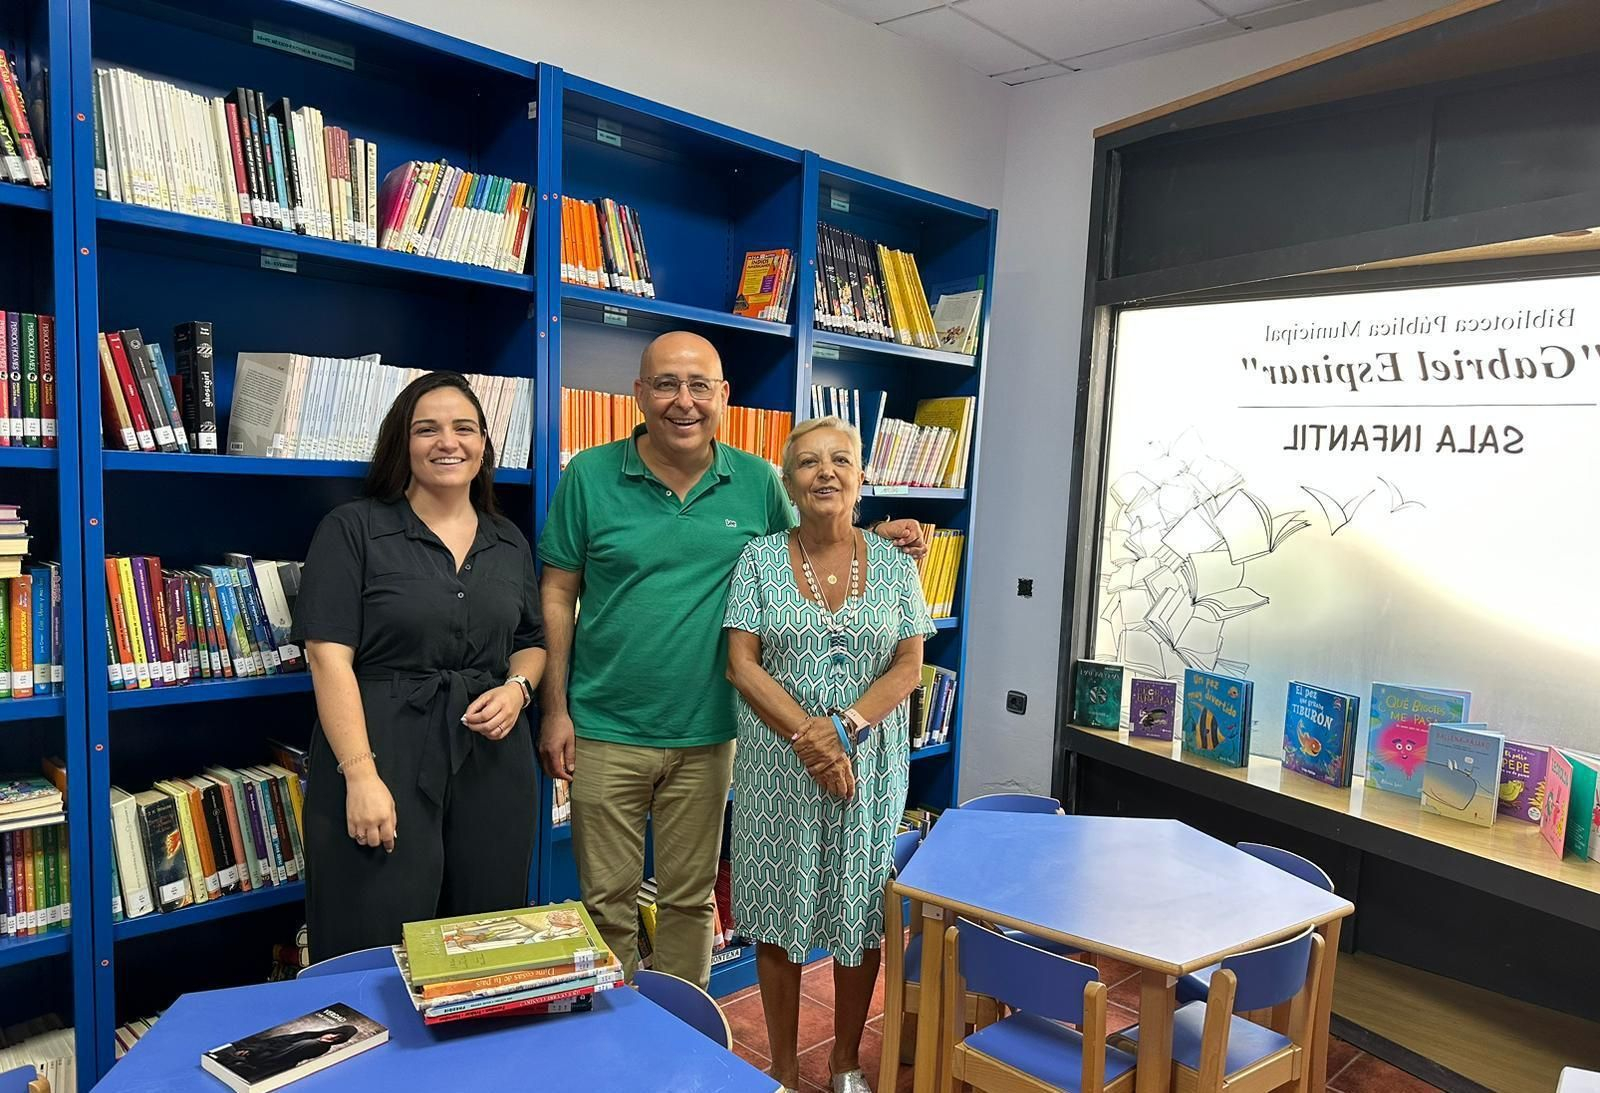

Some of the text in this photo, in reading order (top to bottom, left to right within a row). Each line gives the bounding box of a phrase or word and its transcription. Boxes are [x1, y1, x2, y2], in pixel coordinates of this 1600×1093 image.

[202, 371, 213, 408] ghostgirl
[1206, 678, 1219, 691] pez
[1295, 685, 1318, 701] El pez
[1205, 689, 1237, 718] divertido
[1292, 703, 1334, 731] TIBURÓN
[1390, 711, 1408, 722] ME
[1502, 758, 1530, 774] PEPE
[503, 974, 513, 982] de
[514, 971, 534, 980] cosas
[535, 967, 555, 978] Dime
[493, 977, 502, 985] tu
